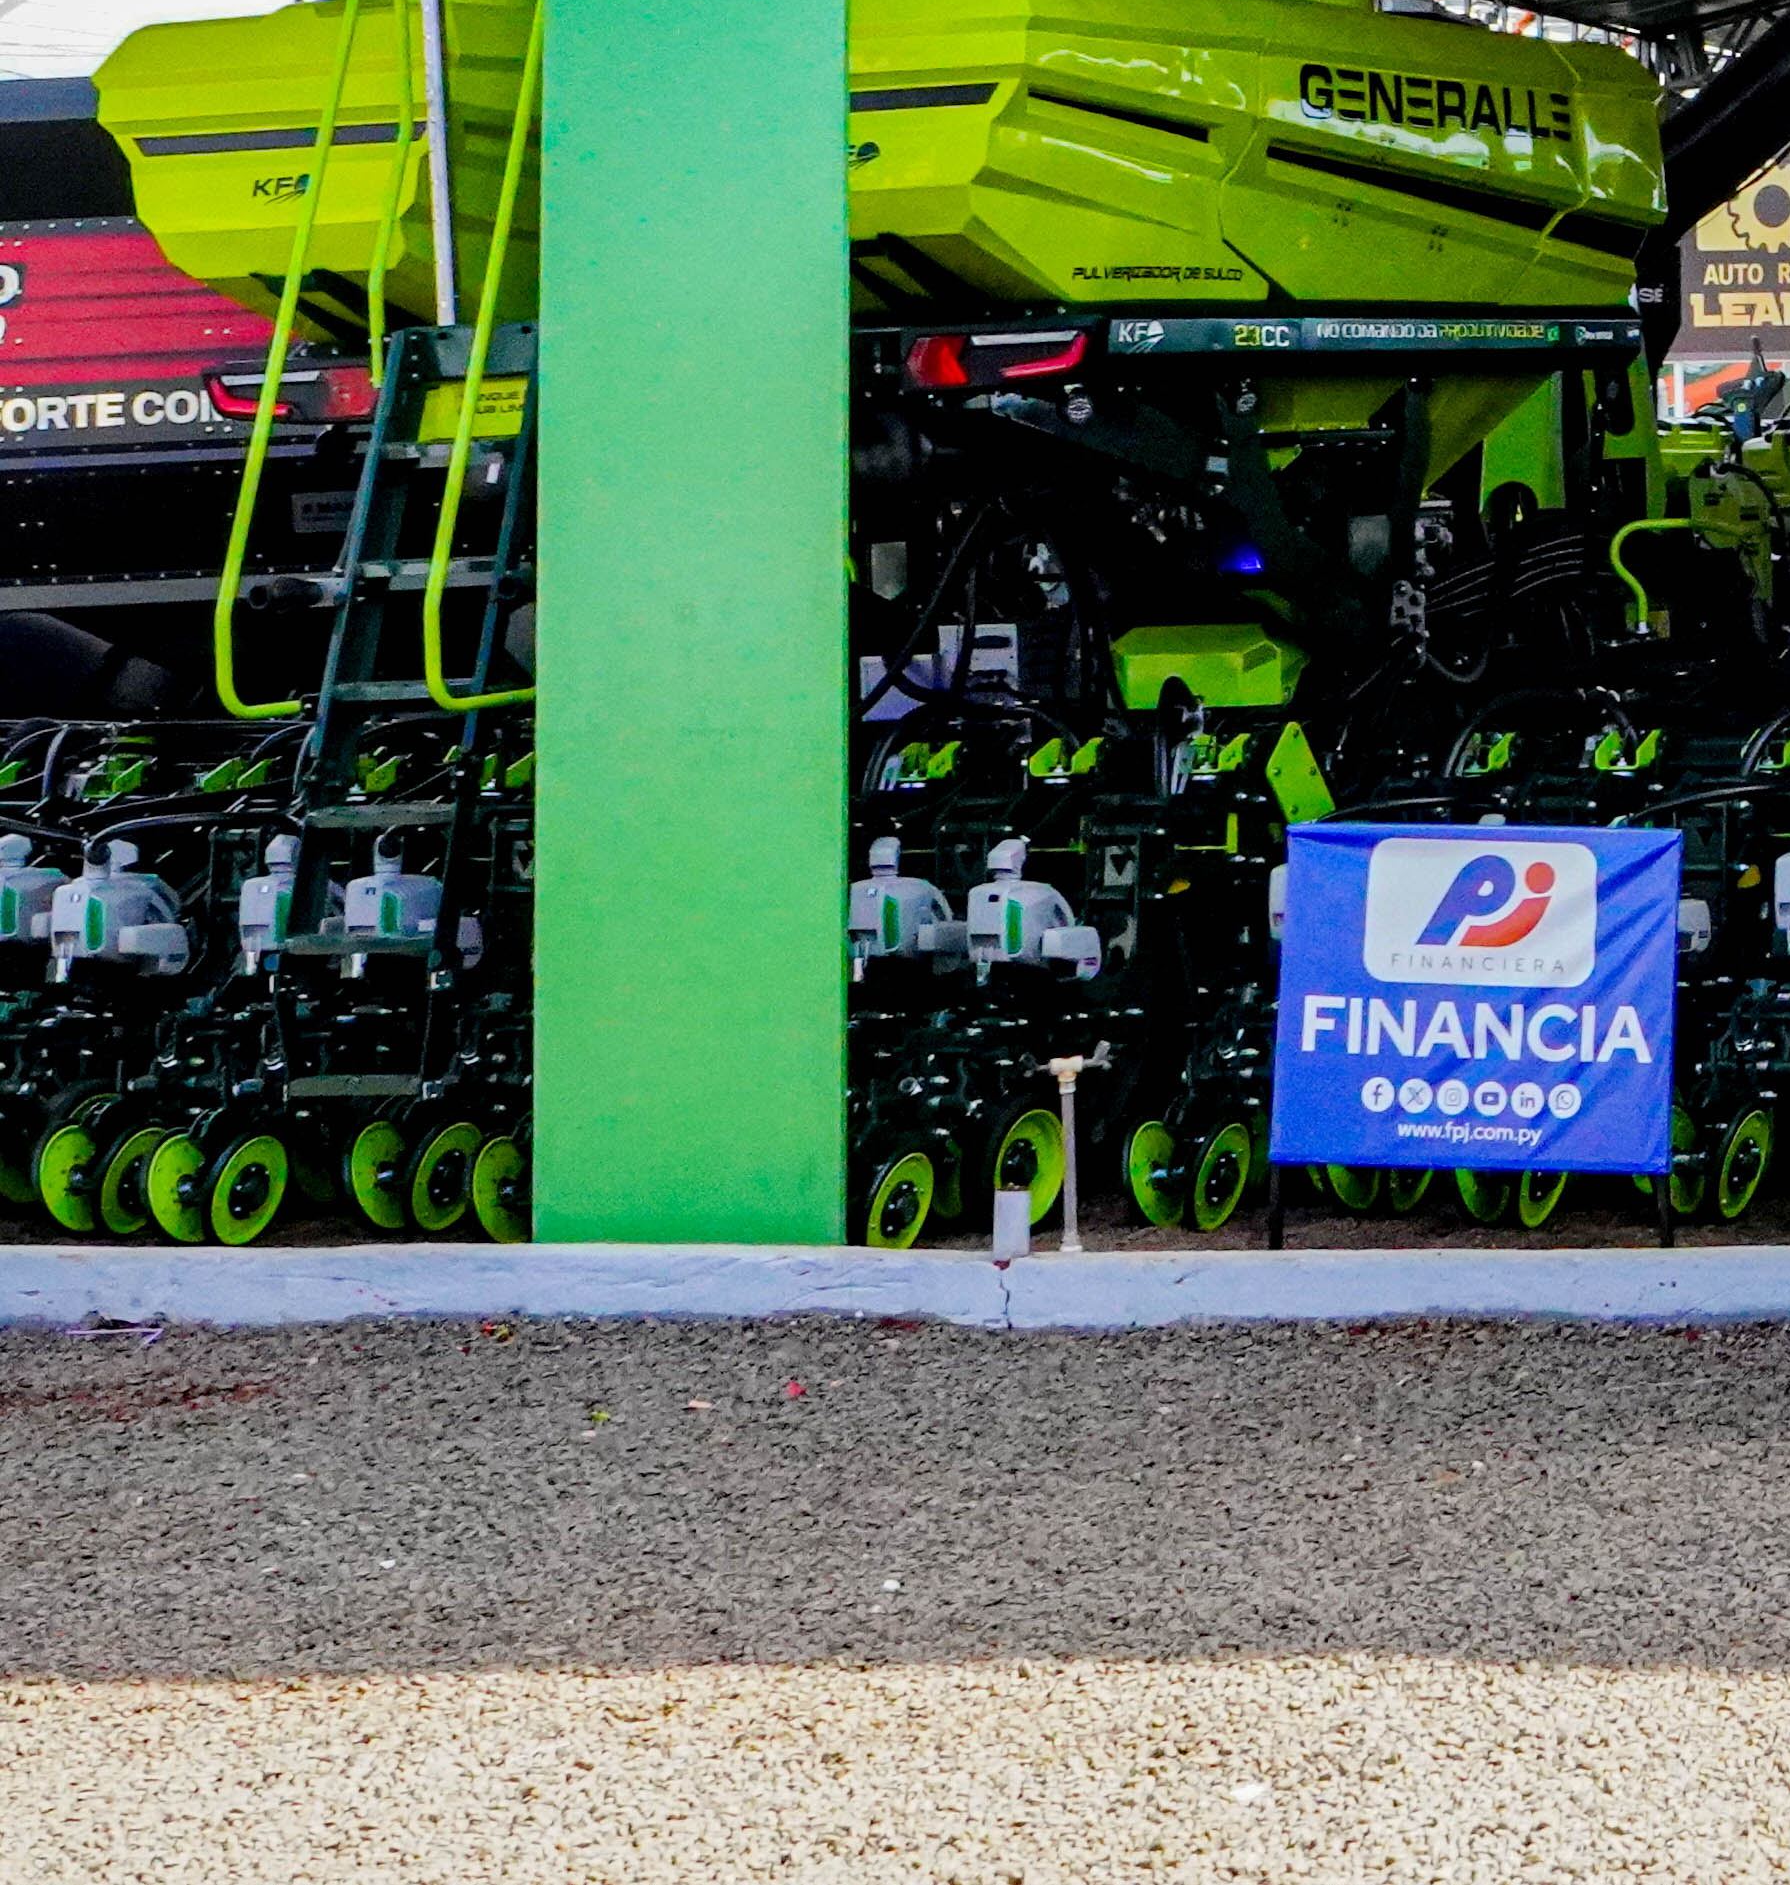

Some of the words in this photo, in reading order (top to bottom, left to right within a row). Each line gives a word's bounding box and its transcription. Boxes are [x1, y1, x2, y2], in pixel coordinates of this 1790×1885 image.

[1300, 63, 1571, 141] GENERALLE
[1703, 263, 1765, 285] AUTO
[1234, 324, 1290, 347] 23CC
[0, 393, 125, 432] ORTE
[1391, 953, 1565, 973] FINANCIERA
[1302, 994, 1652, 1064] FINANCIA
[1398, 1121, 1542, 1146] www.fpj.com.py
